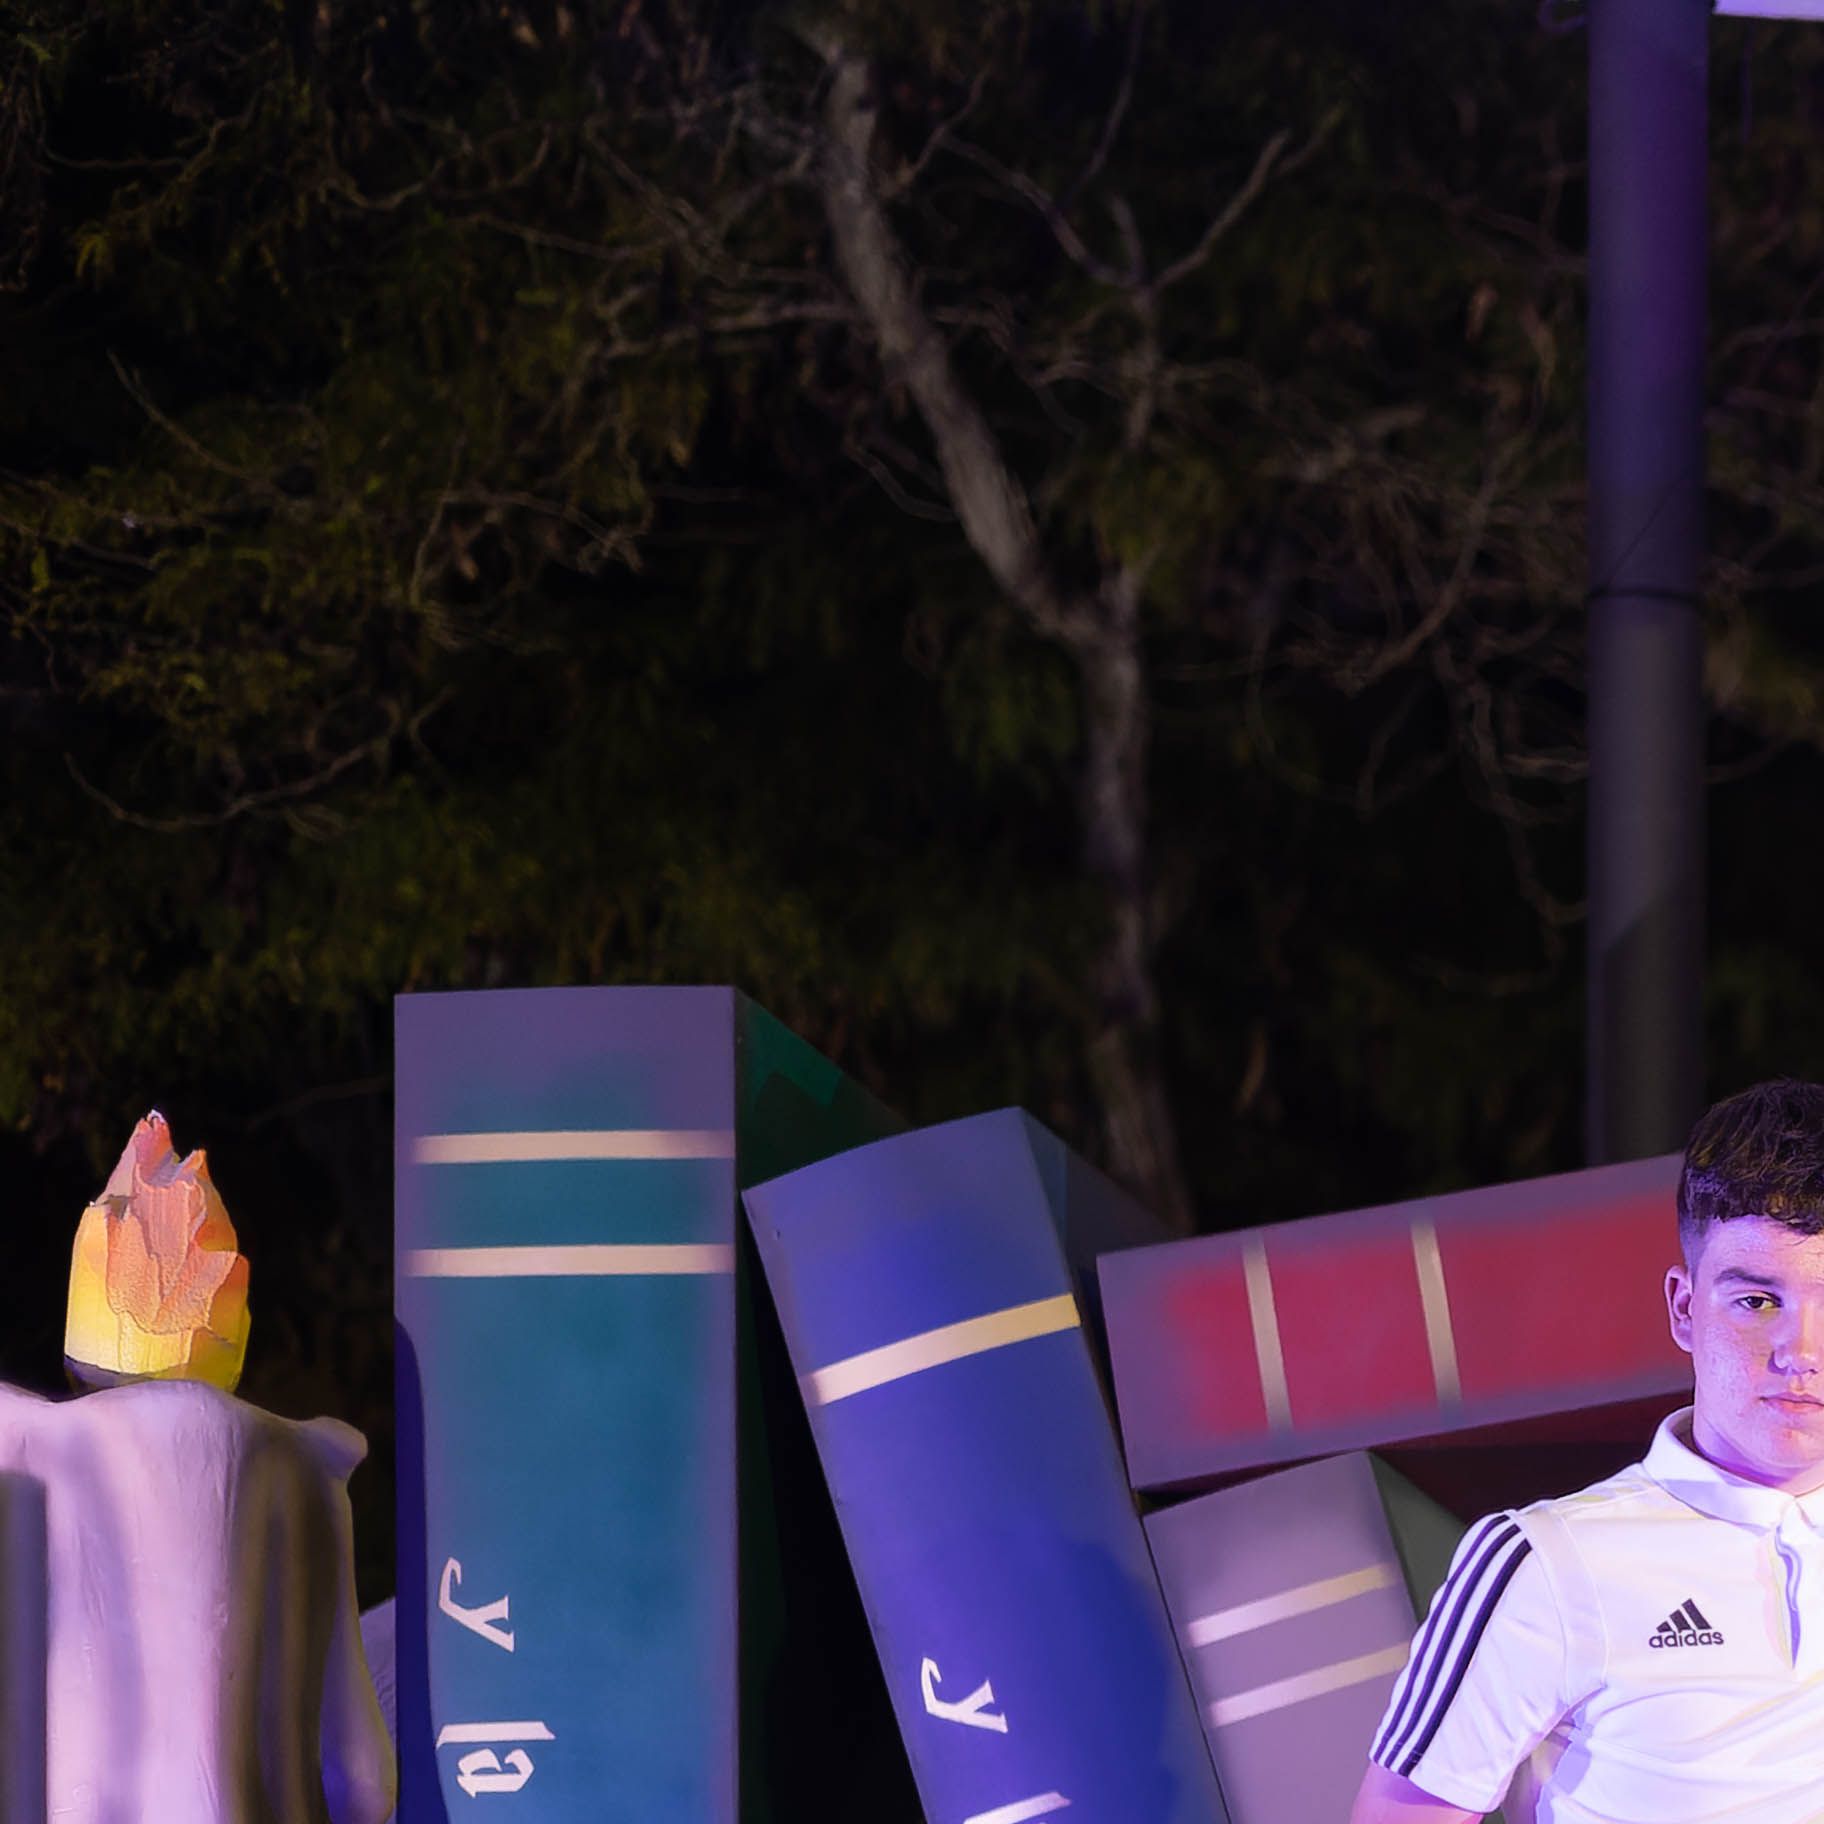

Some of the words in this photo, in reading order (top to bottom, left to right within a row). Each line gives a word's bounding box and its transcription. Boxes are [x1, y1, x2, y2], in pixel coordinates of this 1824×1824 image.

[438, 1557, 515, 1653] y
[1649, 1629, 1724, 1648] adidas
[921, 1657, 1008, 1733] y
[436, 1720, 556, 1798] la
